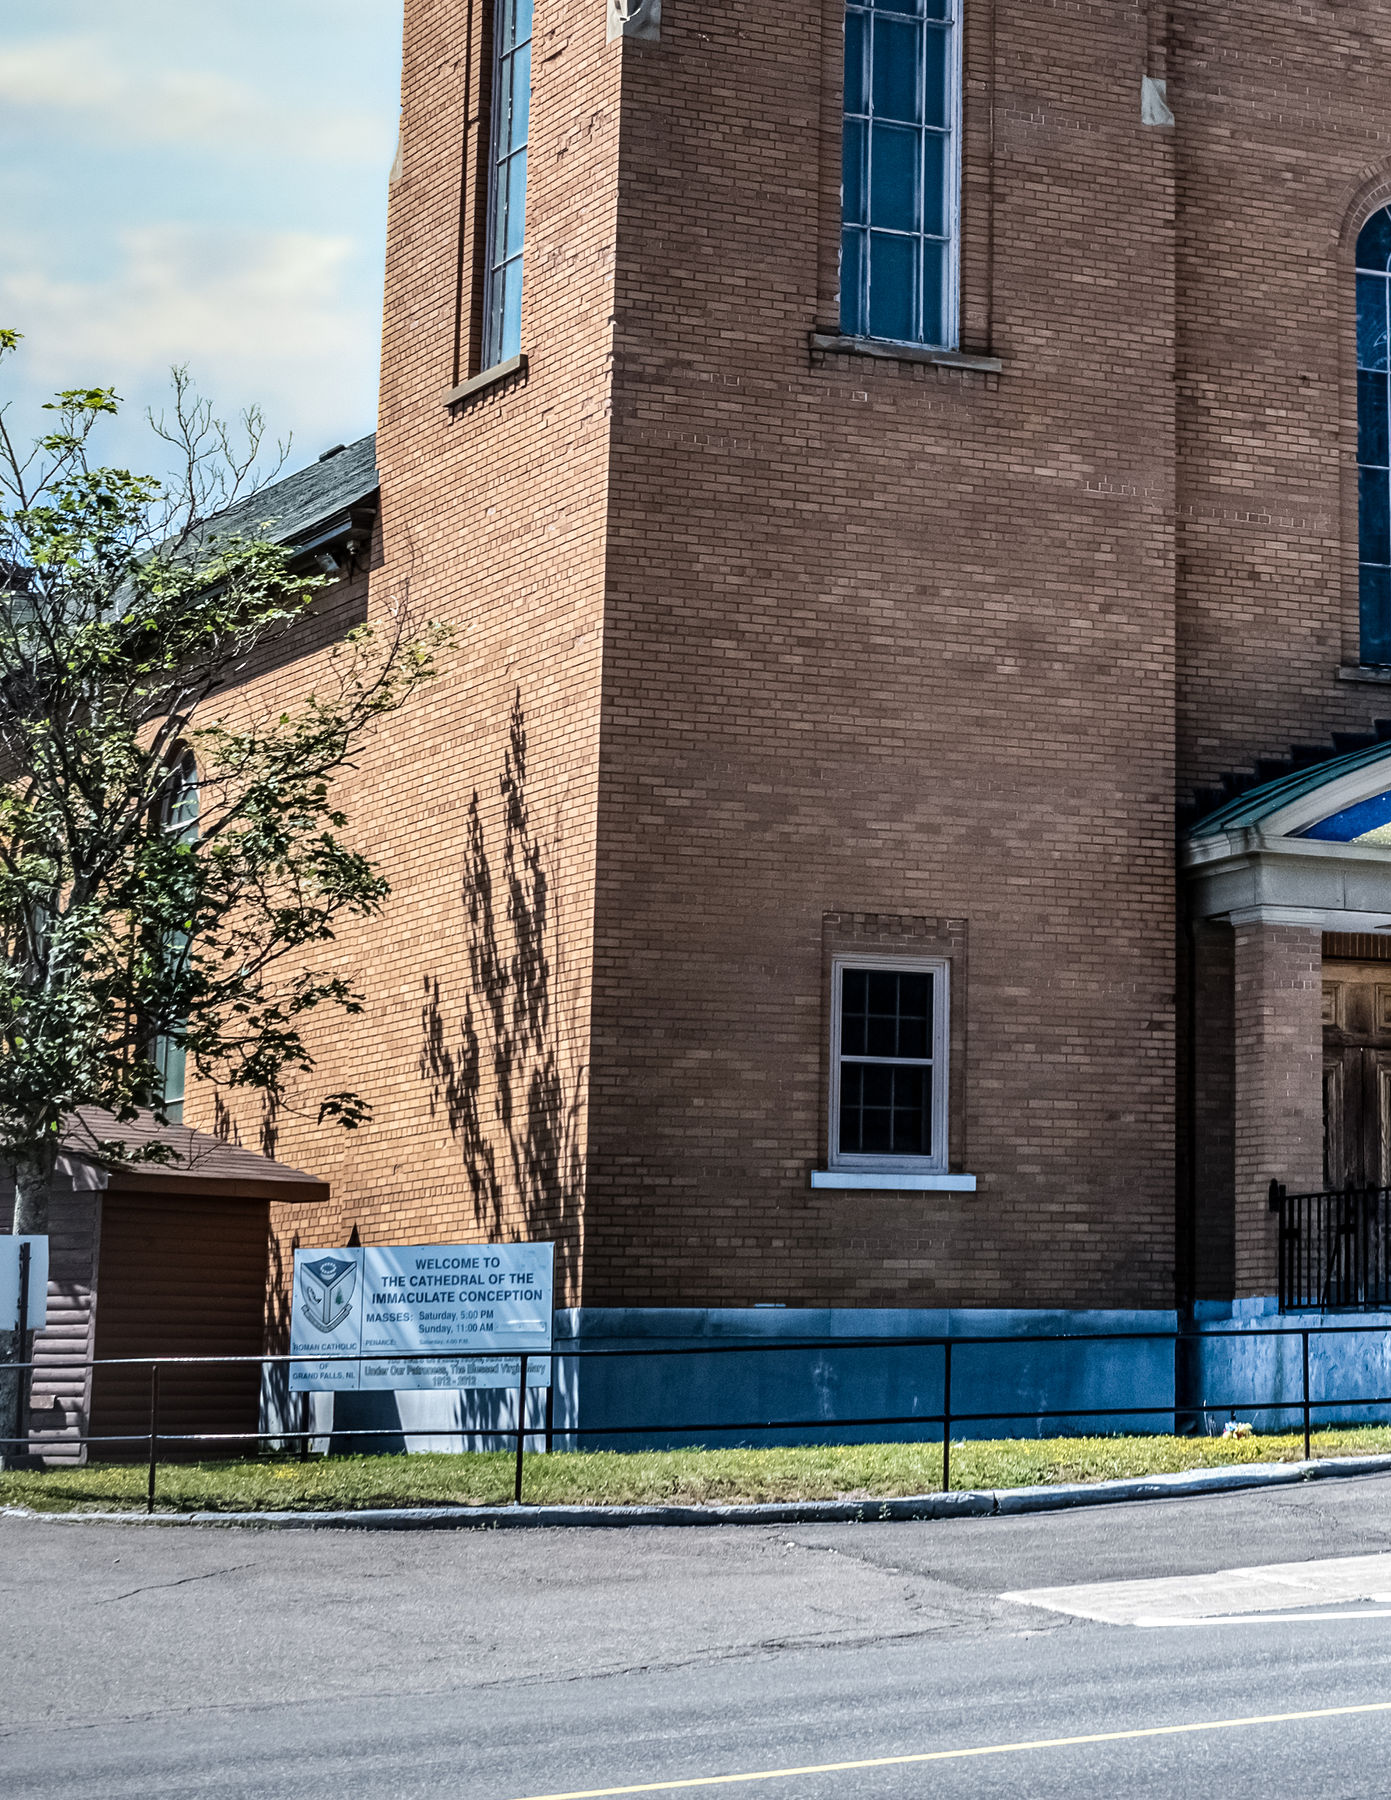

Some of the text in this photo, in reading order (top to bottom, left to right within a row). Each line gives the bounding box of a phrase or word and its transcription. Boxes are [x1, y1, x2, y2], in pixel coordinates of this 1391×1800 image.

[415, 1257, 500, 1270] WELCOME TO
[381, 1273, 534, 1287] THE CATHEDRAL OF THE
[372, 1289, 543, 1304] IMMACULATE CONCEPTION
[366, 1310, 494, 1322] MASSES: Saturday, 5:00 PM
[418, 1323, 494, 1334] Sunday, 11:00 AM
[293, 1342, 358, 1351] ROMAN CATHOLIC
[319, 1362, 330, 1370] OF
[390, 1365, 405, 1376] Our
[501, 1364, 521, 1375] Virgi
[292, 1372, 319, 1380] GRAND
